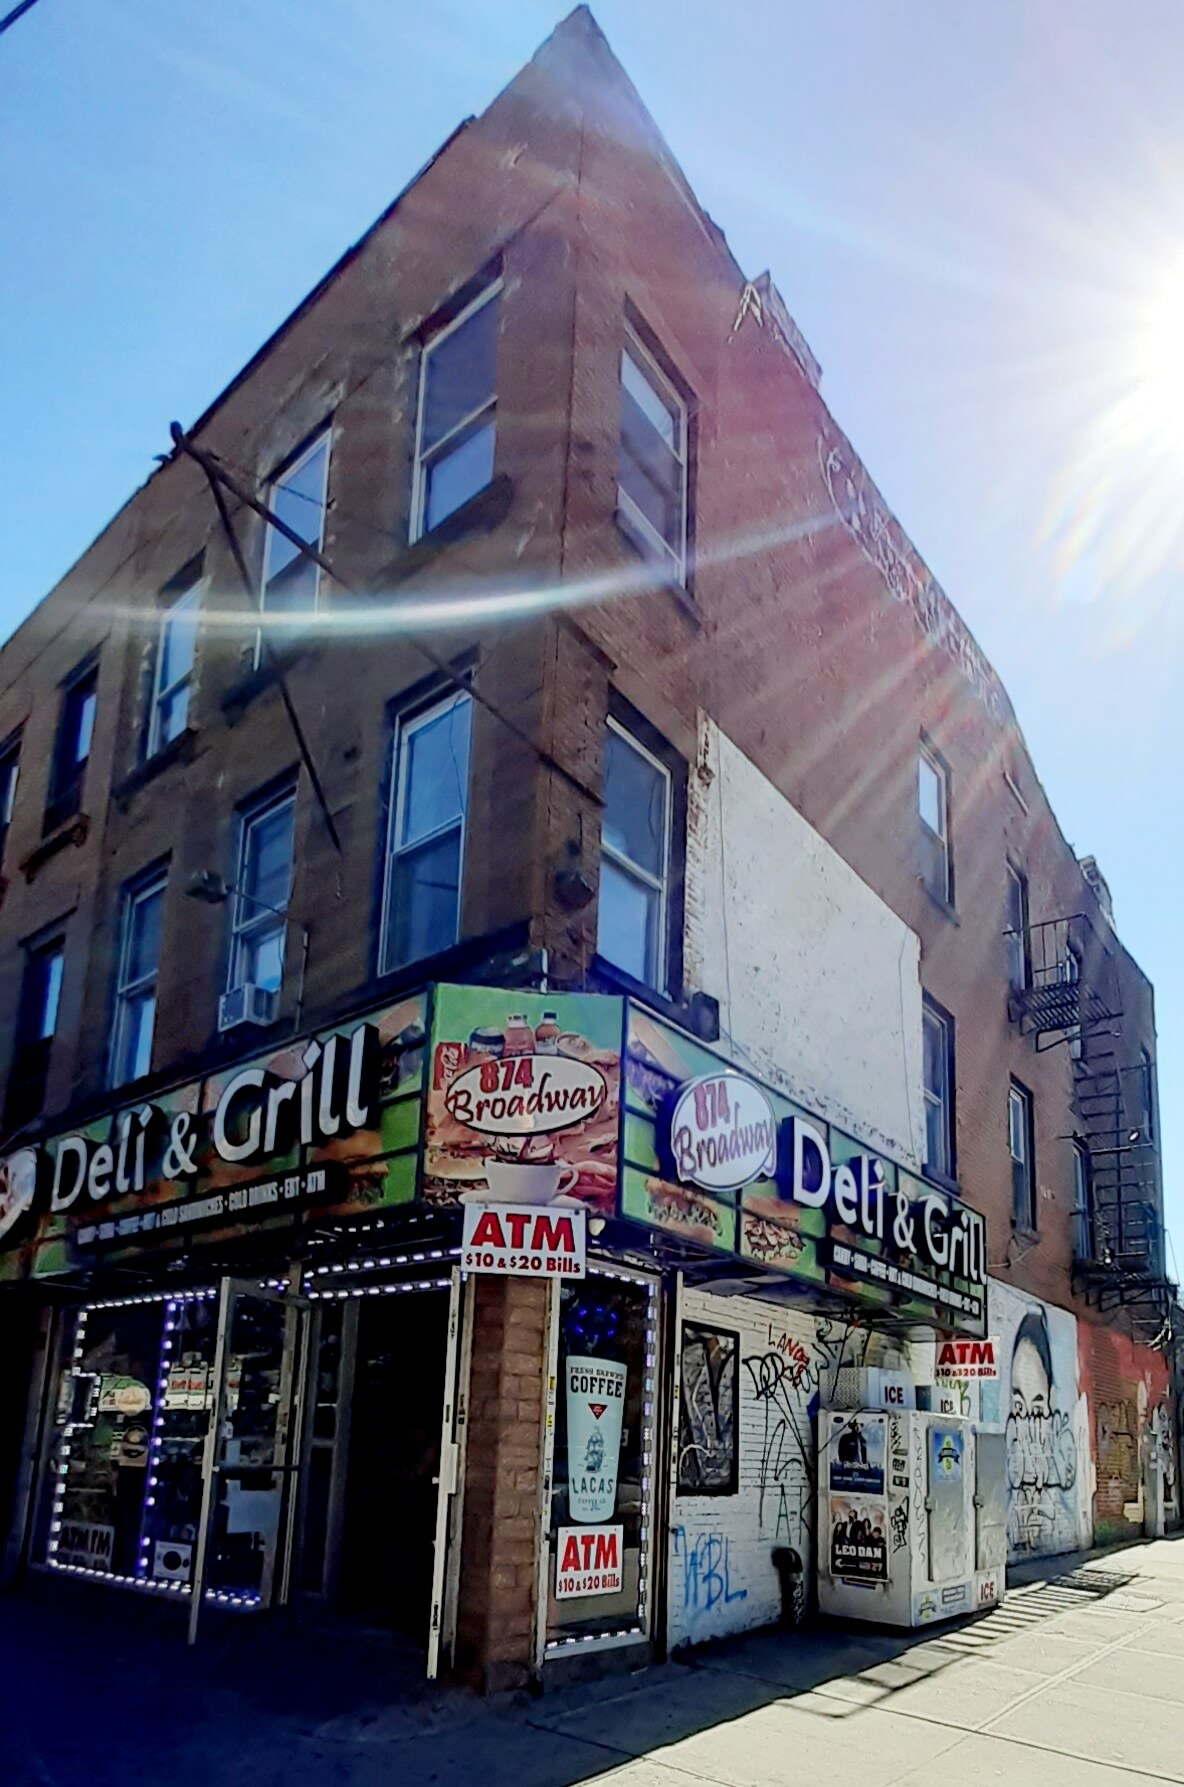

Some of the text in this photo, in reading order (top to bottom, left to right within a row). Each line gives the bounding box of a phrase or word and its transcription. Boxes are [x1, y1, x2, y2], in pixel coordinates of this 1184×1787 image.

[480, 1058, 534, 1093] 874
[445, 1073, 606, 1122] Broadway
[694, 1081, 730, 1131] 874
[51, 1024, 369, 1213] Deli & Grill
[674, 1102, 776, 1177] Broadway
[793, 1116, 885, 1239] Deli
[893, 1192, 918, 1254] &
[924, 1195, 987, 1286] Grill
[470, 1212, 576, 1253] ATM
[466, 1253, 581, 1273] $10 & $20 Bills
[938, 1342, 994, 1365] ATM
[571, 1375, 623, 1398] COFFEE
[884, 1385, 904, 1404] ICE
[572, 1477, 614, 1494] LACAS
[561, 1534, 618, 1572] ATM
[835, 1544, 882, 1559] LEO DAN
[559, 1578, 574, 1593] $10
[583, 1575, 600, 1590] $20
[602, 1573, 619, 1588] Bills
[981, 1581, 994, 1601] ICE
